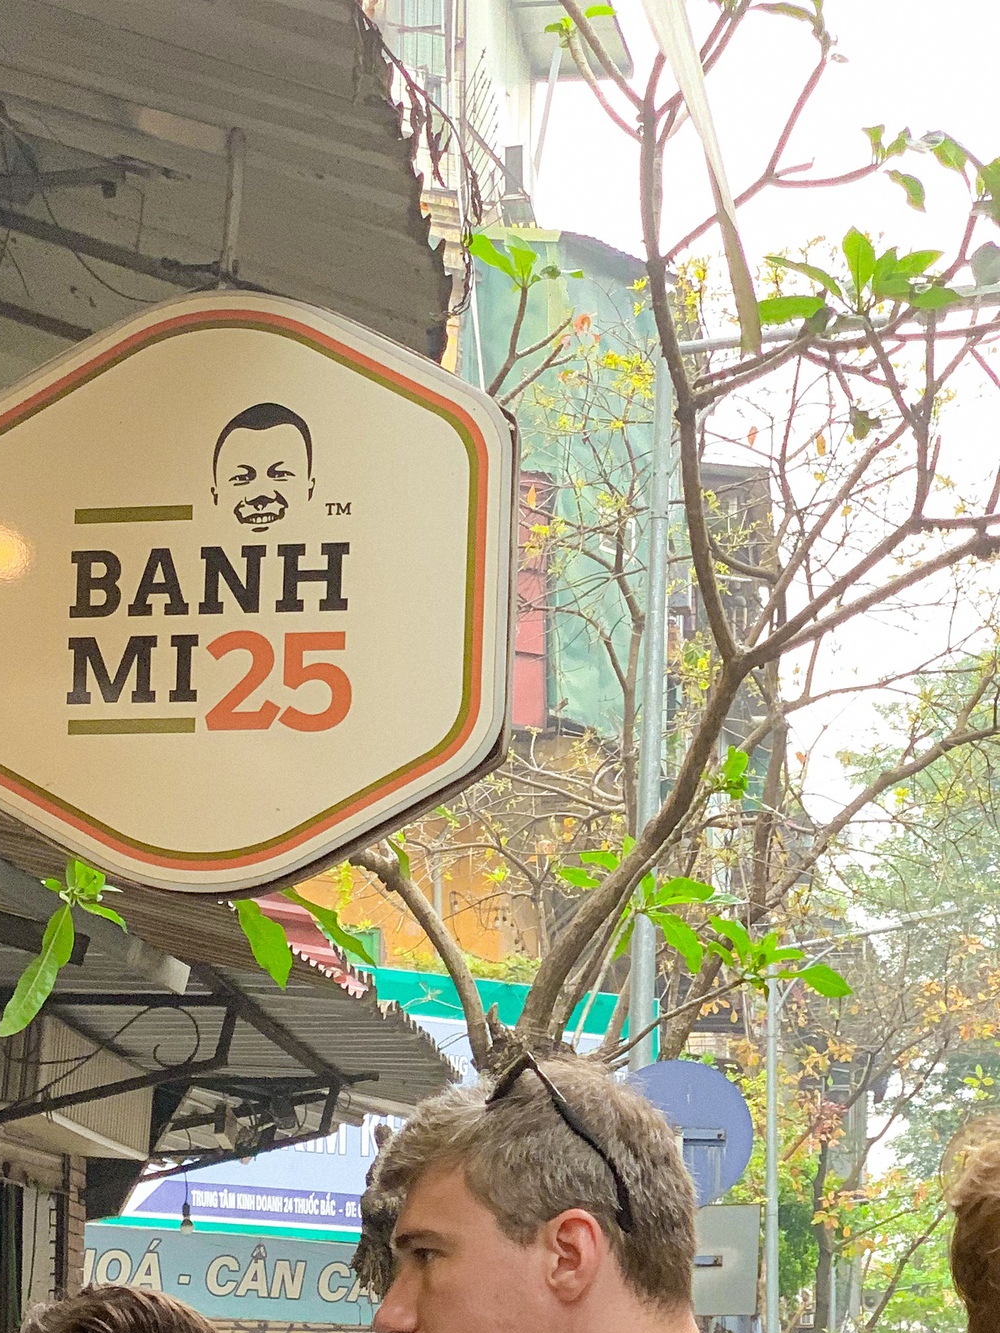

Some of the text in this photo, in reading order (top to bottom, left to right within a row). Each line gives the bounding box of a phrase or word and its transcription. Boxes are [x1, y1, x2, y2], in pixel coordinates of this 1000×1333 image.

[325, 502, 352, 516] TM
[69, 542, 351, 618] BANH
[191, 1189, 218, 1208] TRUNG
[219, 1188, 235, 1209] TÂM
[237, 1192, 255, 1210] KINH
[256, 1195, 283, 1213] DOANH
[284, 1197, 293, 1213] 24
[294, 1192, 319, 1215] THUỐC
[320, 1192, 336, 1216] BẮC
[205, 1244, 307, 1300] CÂN
